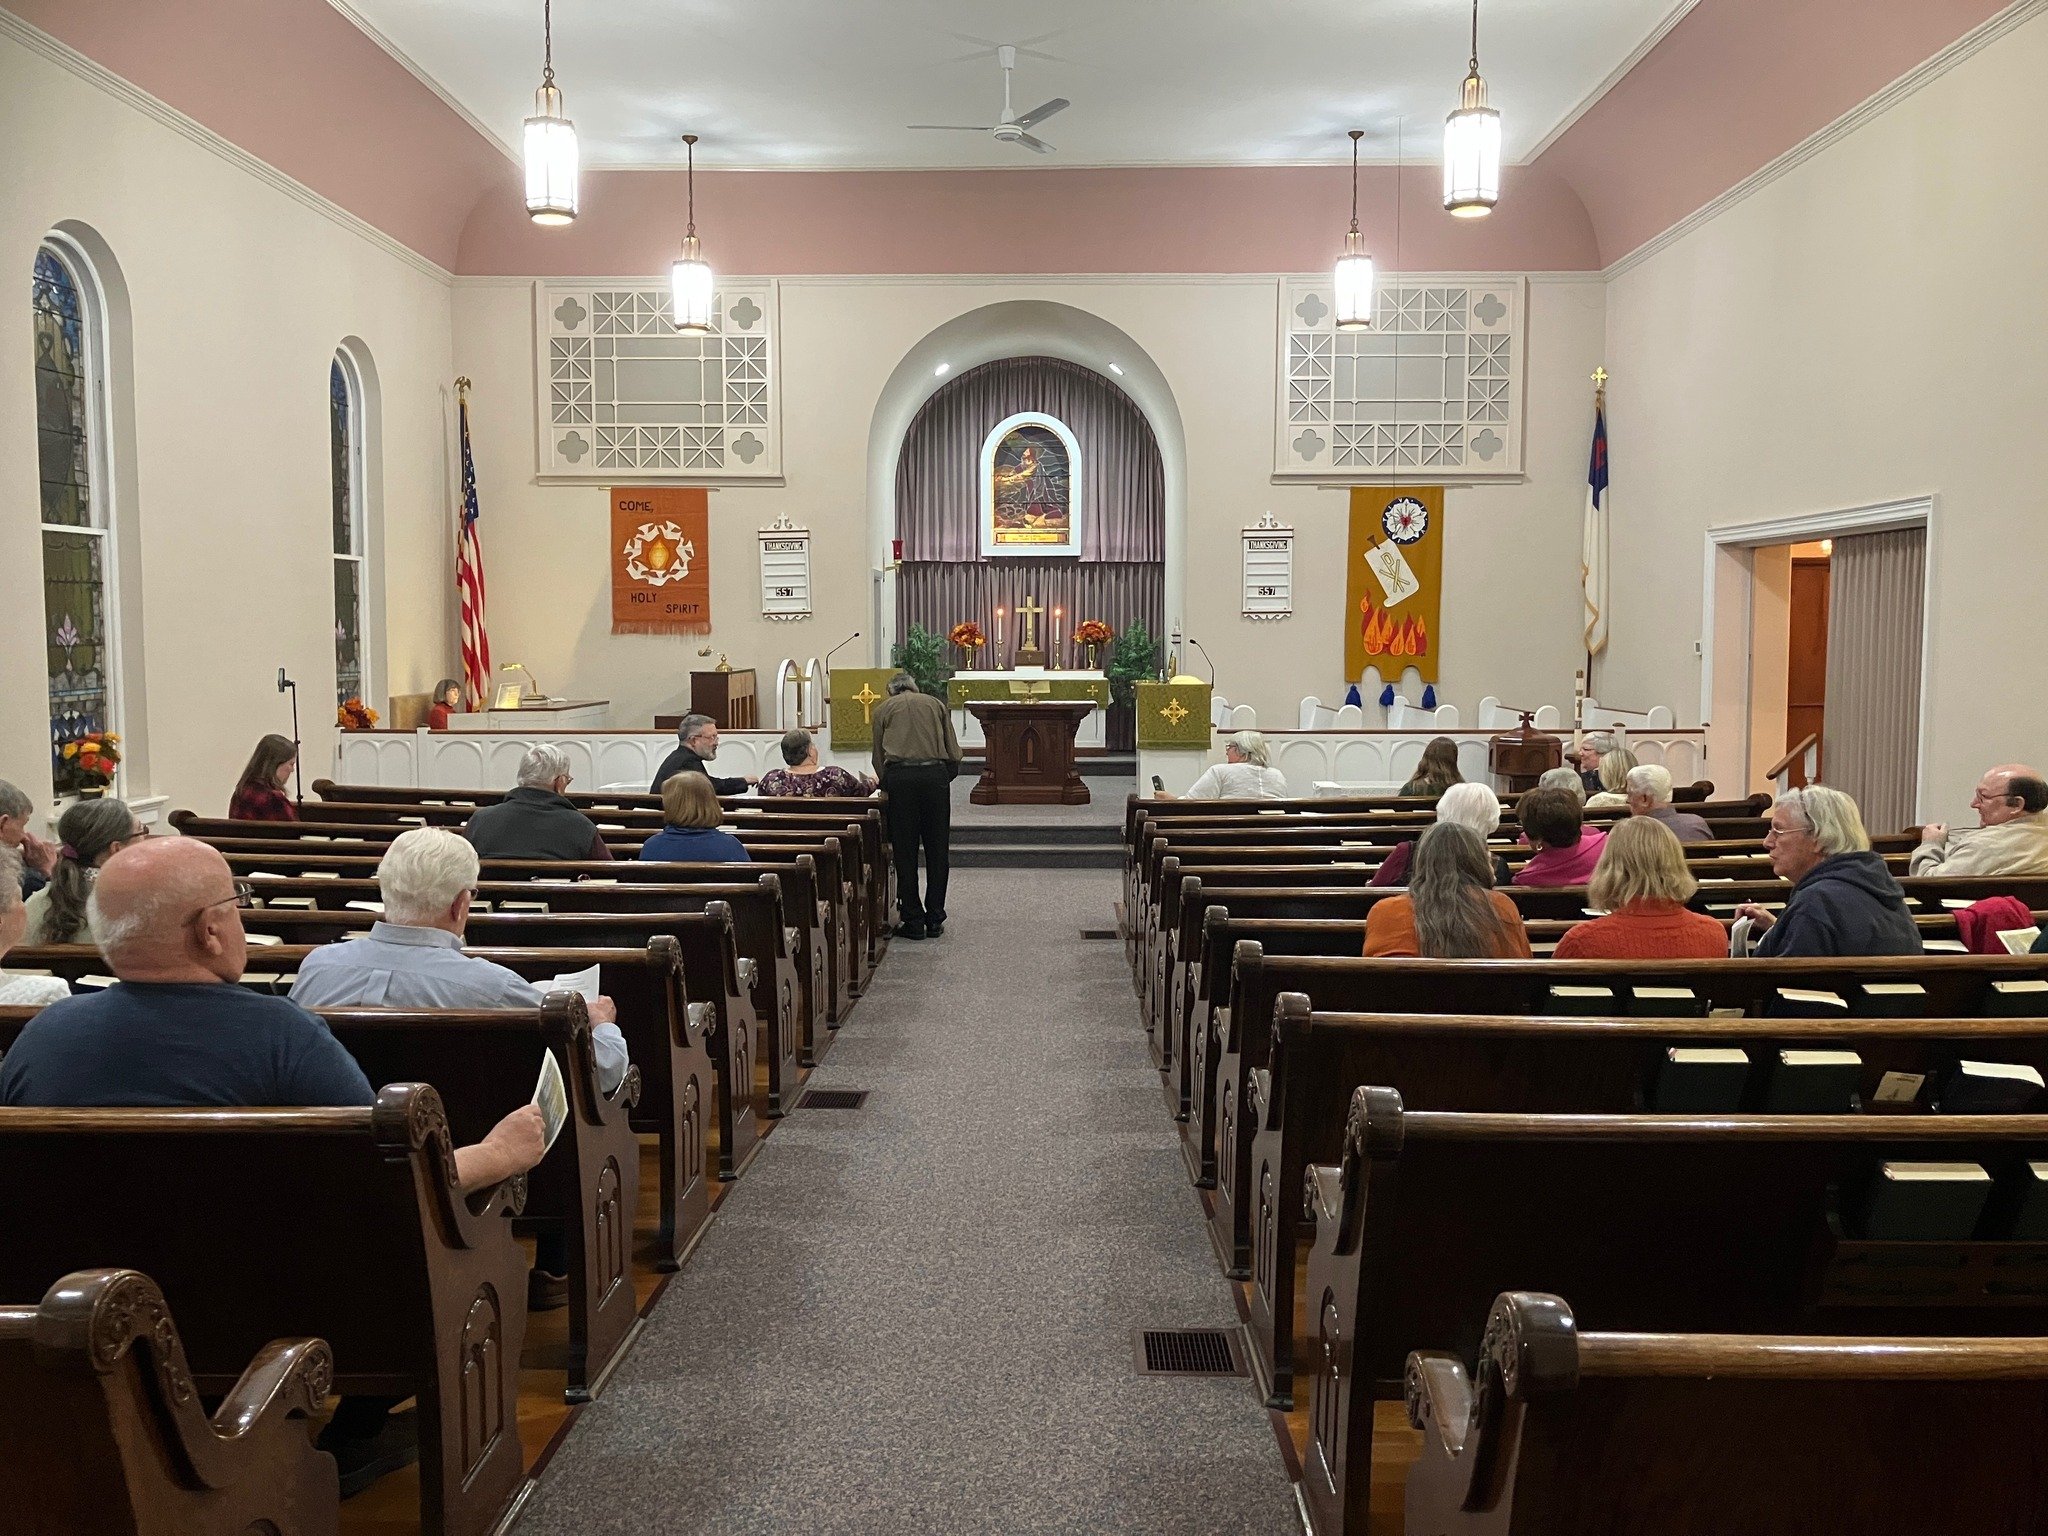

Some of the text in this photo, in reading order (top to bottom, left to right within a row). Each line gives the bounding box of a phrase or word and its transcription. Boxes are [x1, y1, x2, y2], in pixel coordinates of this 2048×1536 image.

[619, 501, 654, 513] COME,
[766, 542, 802, 551] THANKSGIVING
[1250, 540, 1287, 550] THANKSGIVING
[776, 587, 793, 597] 557
[1258, 587, 1276, 596] 557
[630, 592, 658, 603] HOLY
[665, 604, 700, 614] SPIRIT
